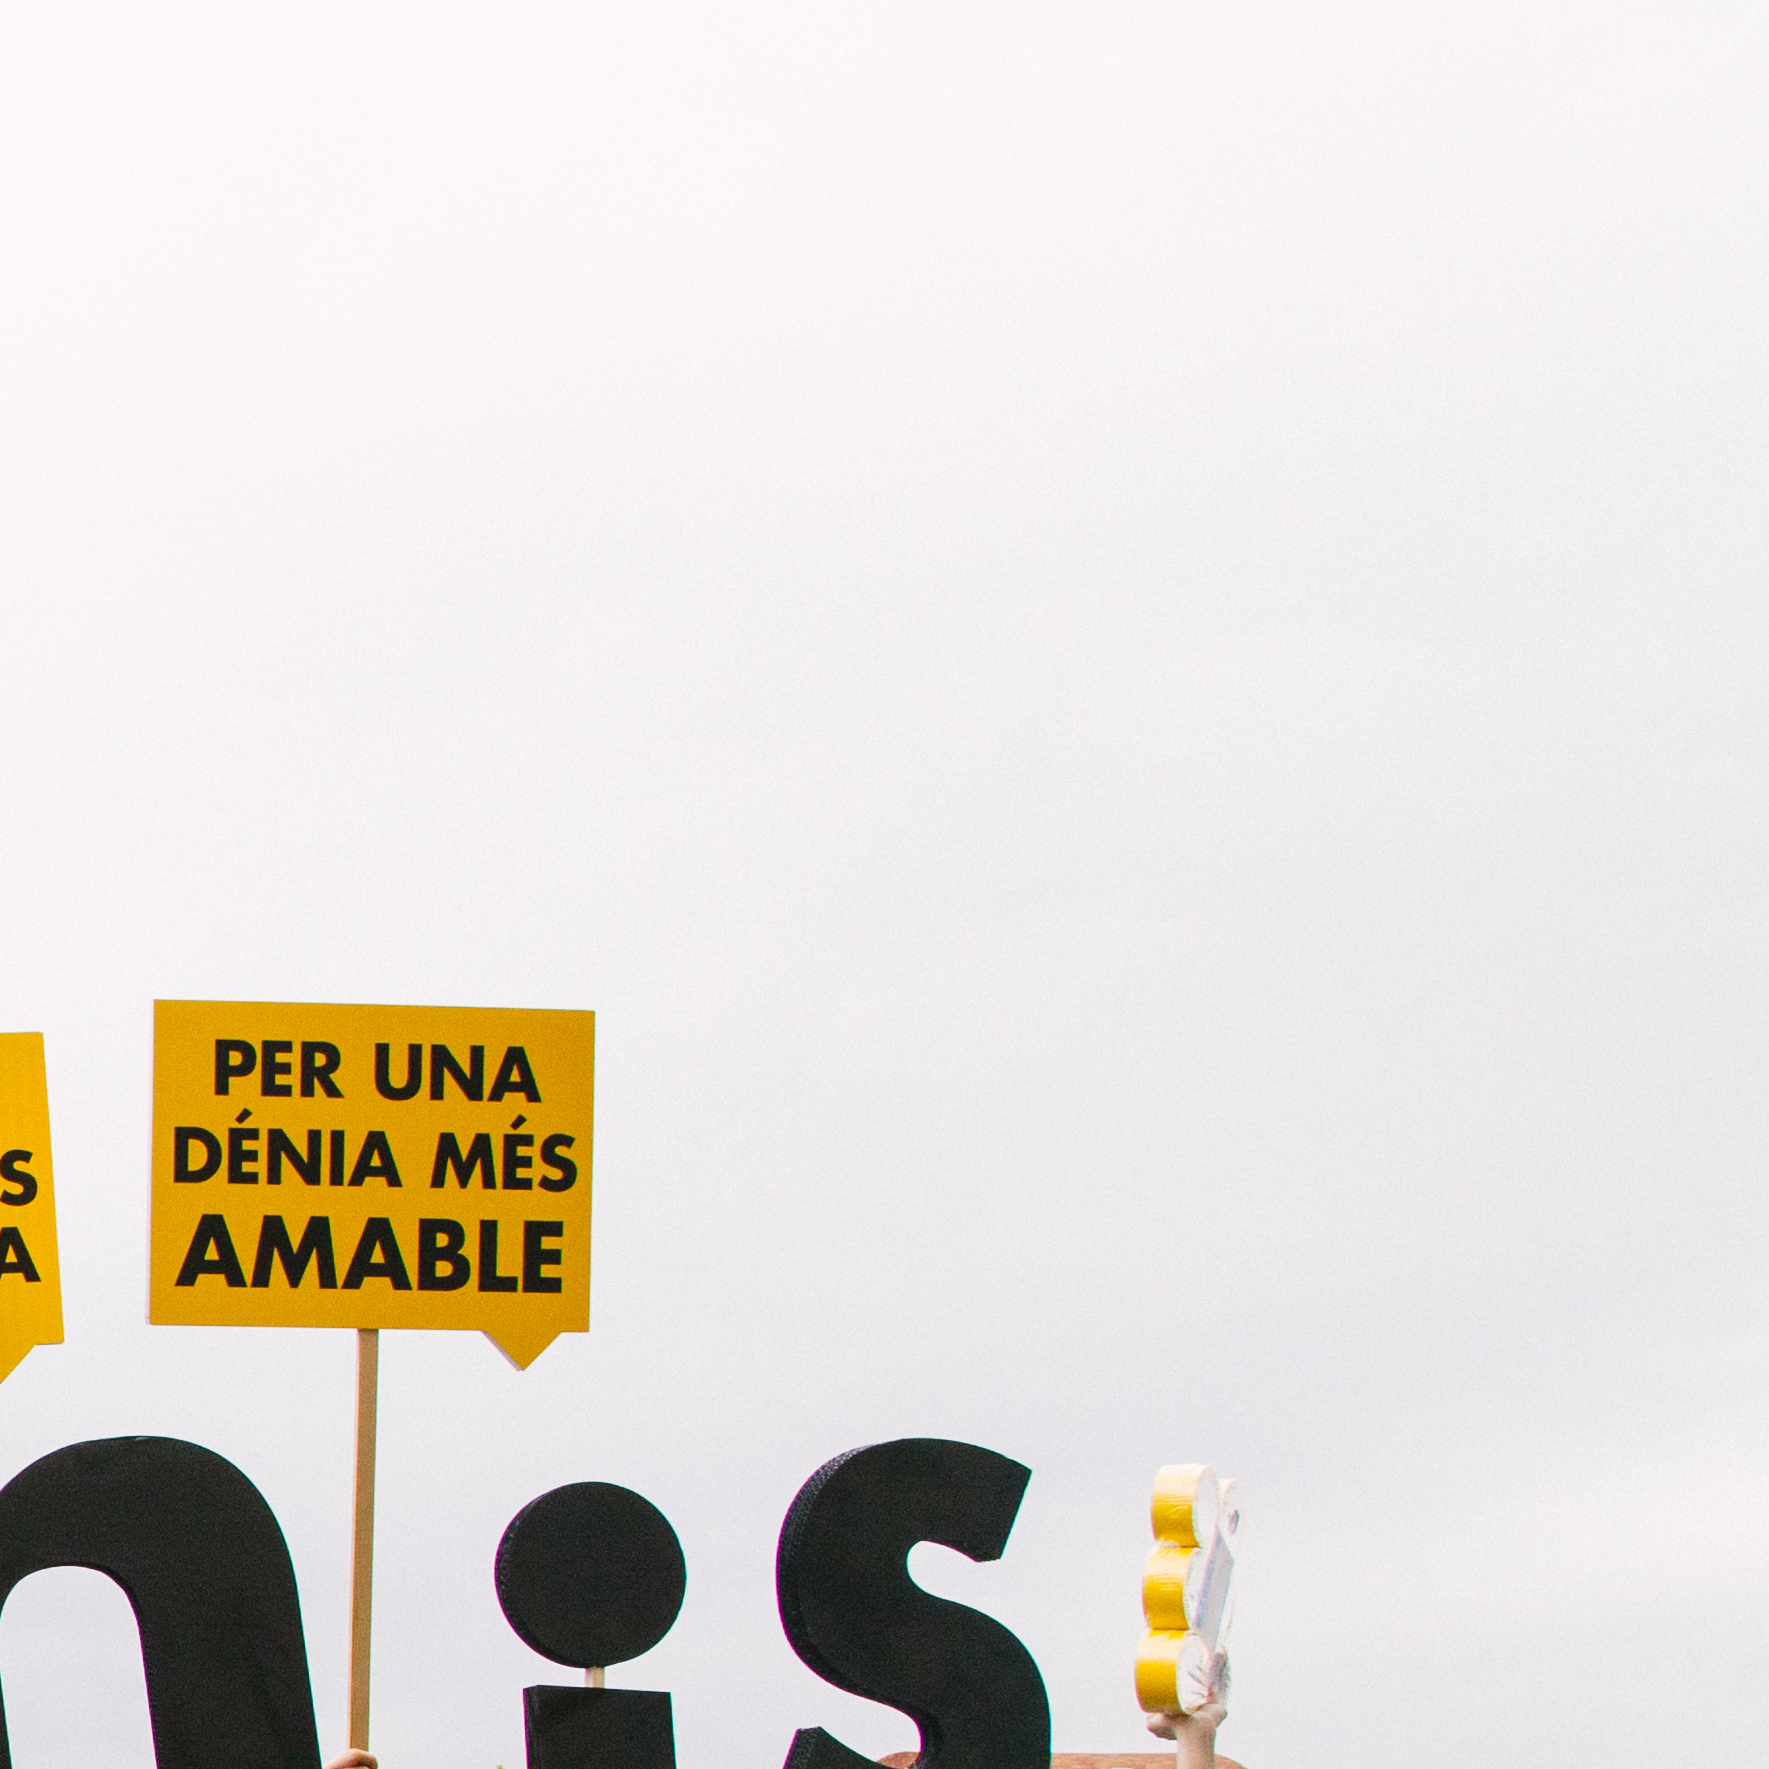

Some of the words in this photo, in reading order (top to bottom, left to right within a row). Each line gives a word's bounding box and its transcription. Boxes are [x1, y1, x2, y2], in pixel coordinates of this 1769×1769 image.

[216, 1039, 344, 1098] PER
[376, 1043, 542, 1102] UNA
[174, 1108, 402, 1187] DÉNIA
[431, 1115, 577, 1192] MÉS
[175, 1214, 564, 1293] AMABLE
